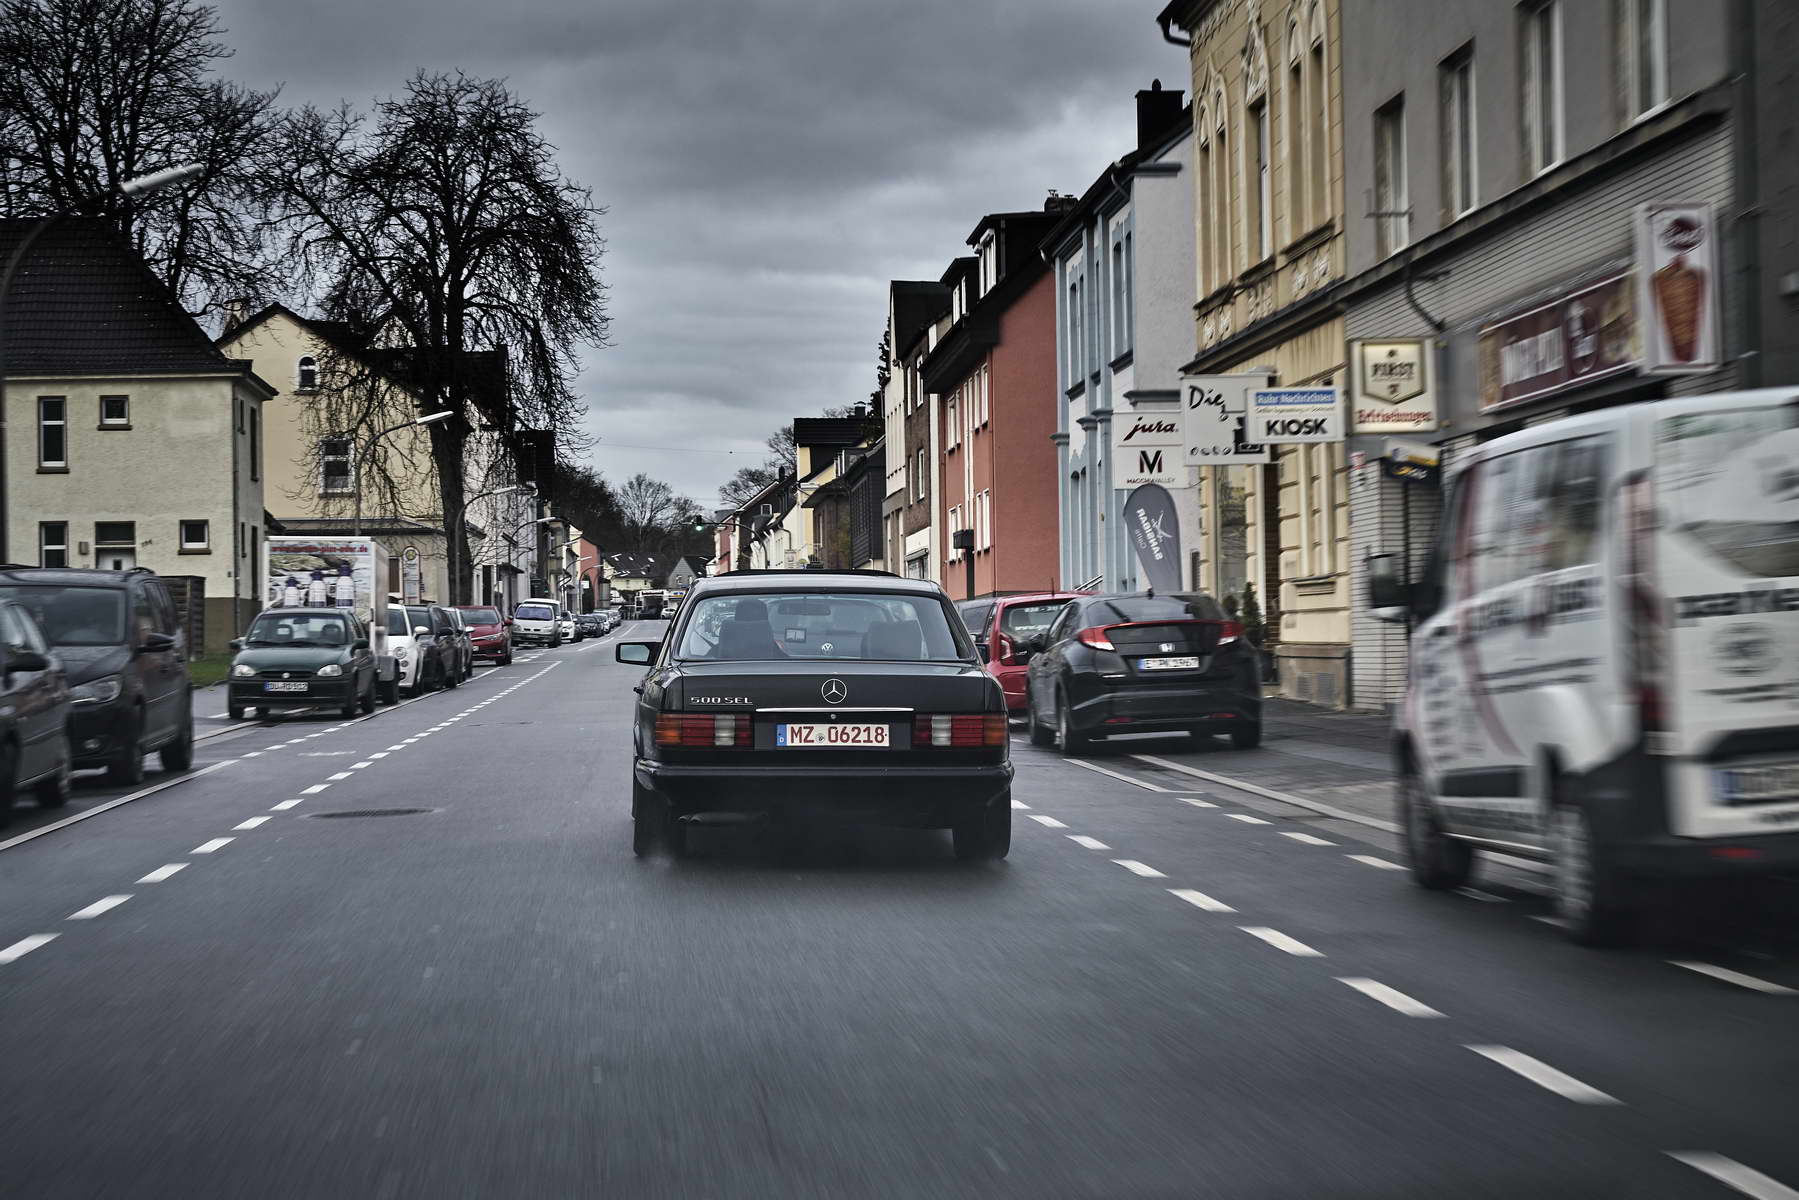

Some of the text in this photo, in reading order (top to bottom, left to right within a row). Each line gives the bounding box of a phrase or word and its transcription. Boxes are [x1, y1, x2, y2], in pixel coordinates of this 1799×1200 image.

[1265, 418, 1328, 436] KIOSK
[690, 696, 753, 705] 500 SEL
[790, 726, 815, 743] MZ
[827, 726, 885, 743] 06218
